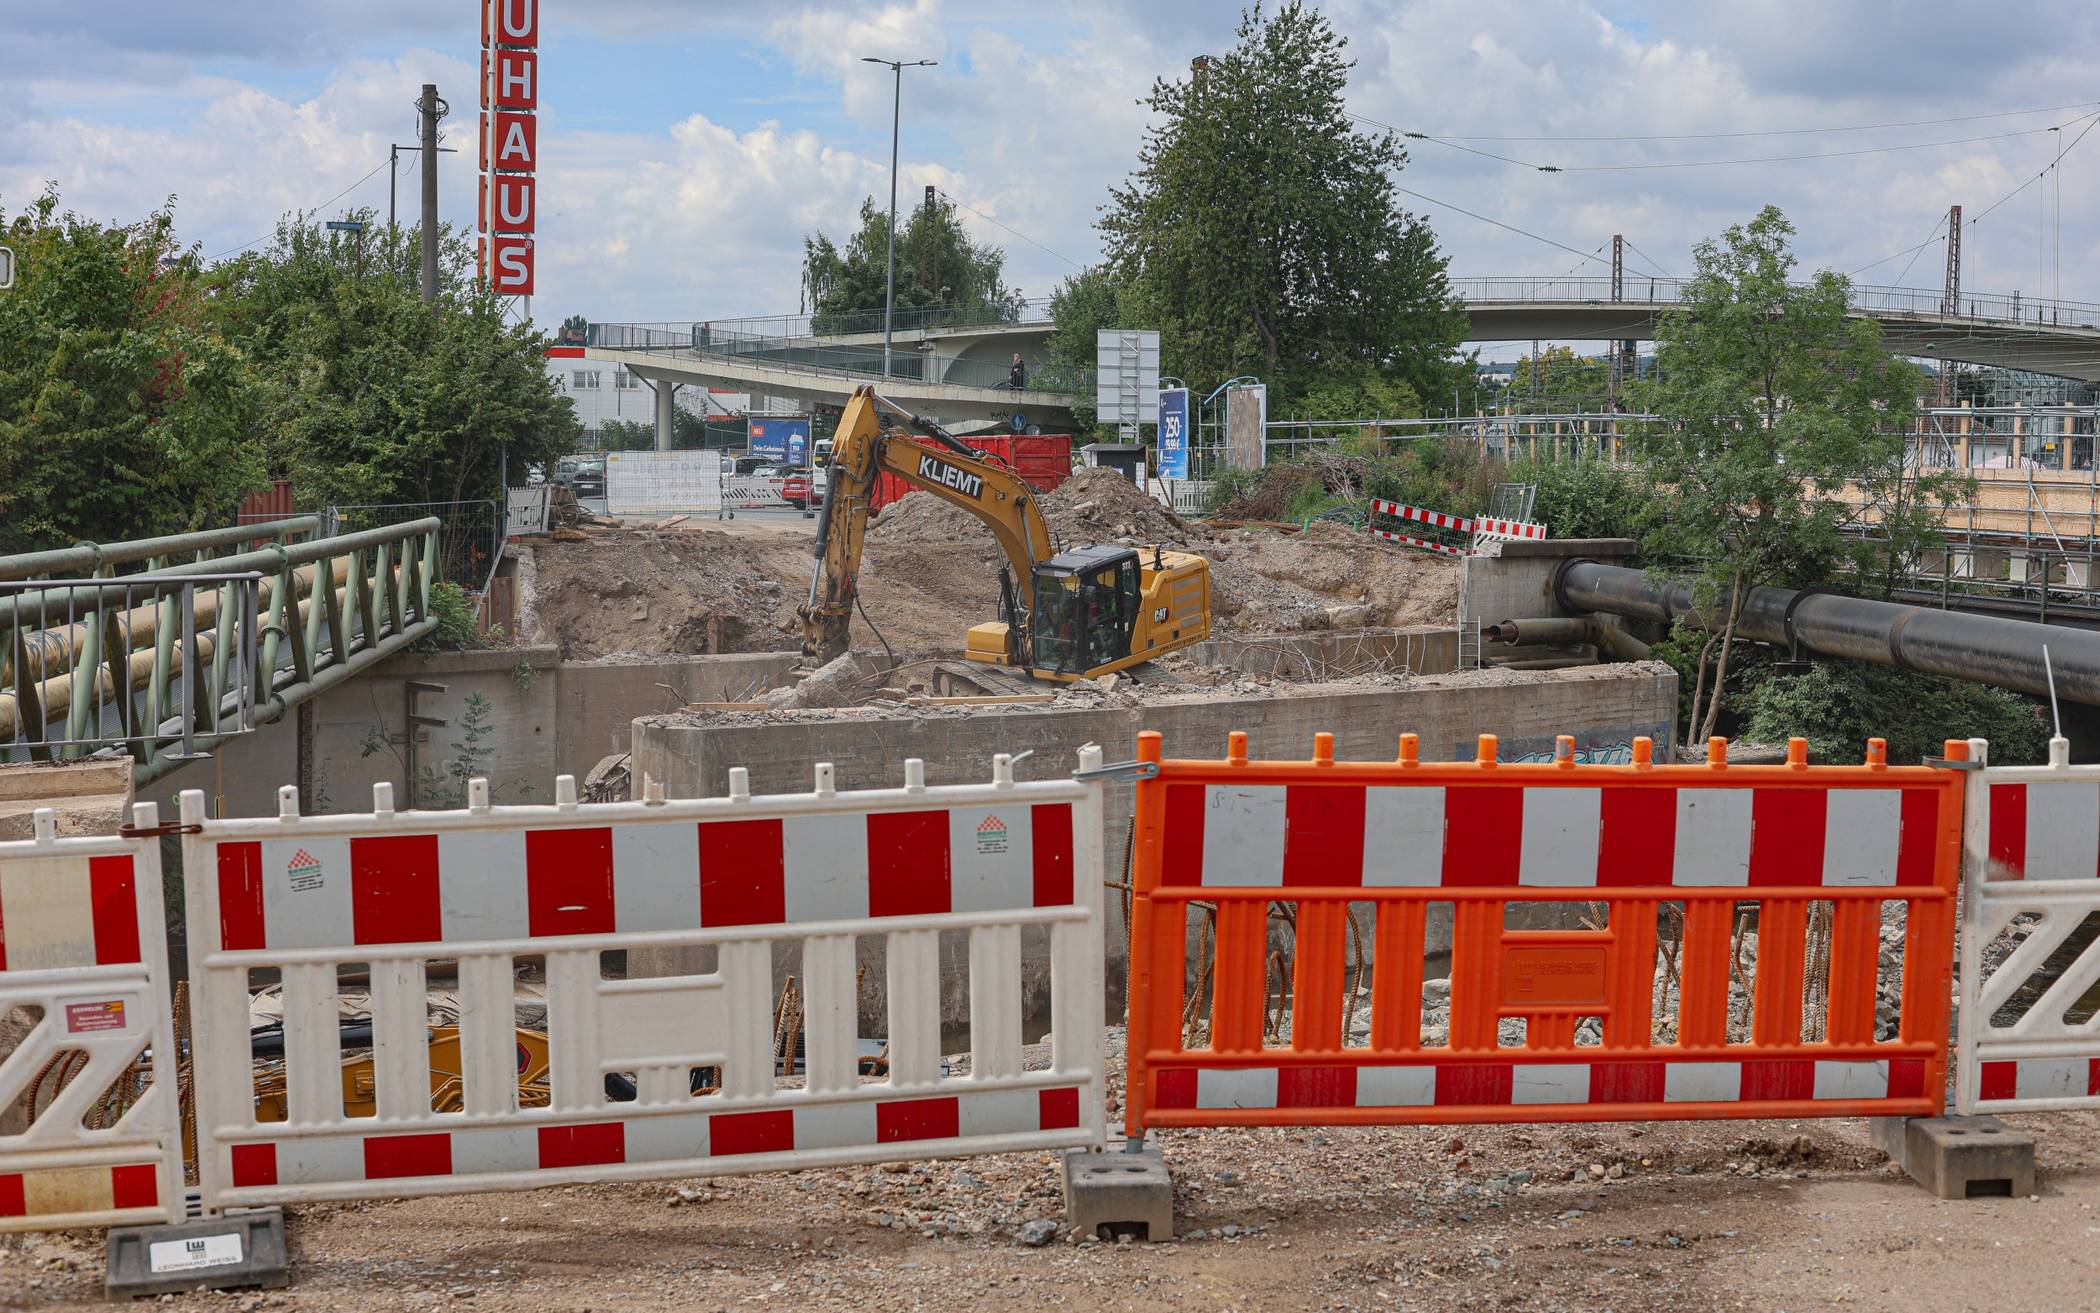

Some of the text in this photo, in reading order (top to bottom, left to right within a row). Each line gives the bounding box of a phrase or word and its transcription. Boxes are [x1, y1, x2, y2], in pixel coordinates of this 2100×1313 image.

[919, 455, 981, 496] KLIEMT
[1154, 607, 1168, 623] CAT
[158, 1260, 207, 1271] LEONHARD
[209, 1256, 237, 1264] WEISS
